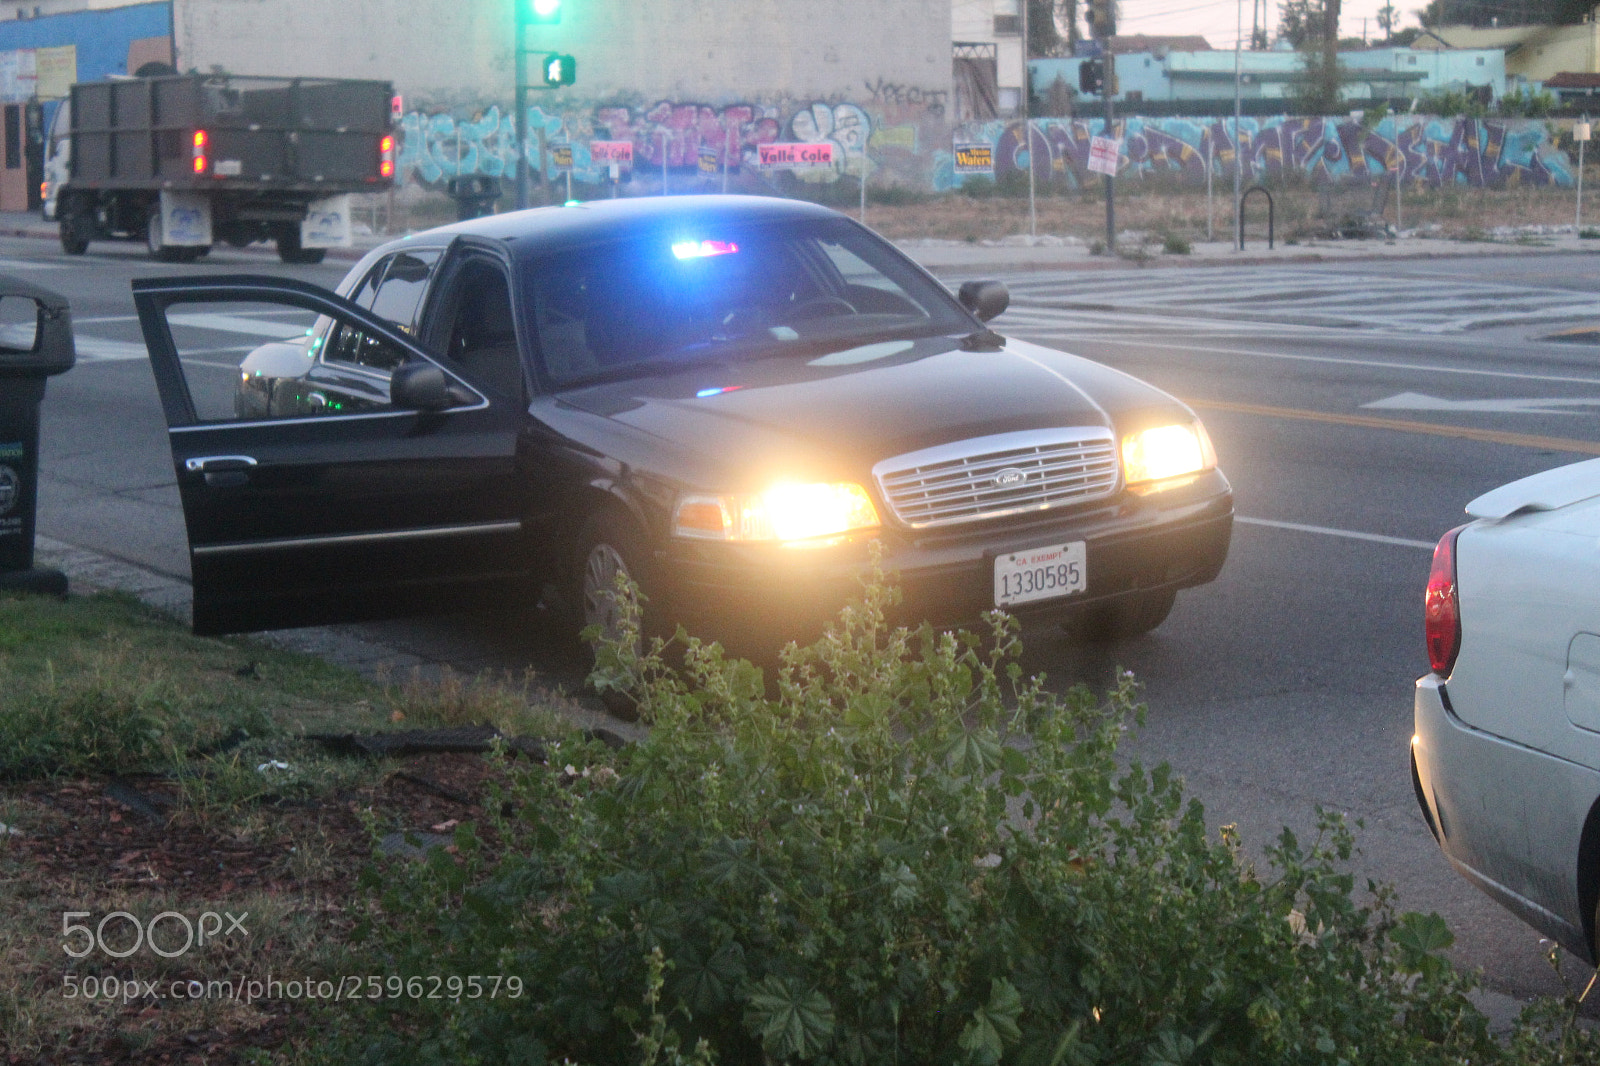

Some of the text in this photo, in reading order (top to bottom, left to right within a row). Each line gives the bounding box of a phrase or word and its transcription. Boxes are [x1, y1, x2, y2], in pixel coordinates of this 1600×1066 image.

[801, 148, 830, 162] Cole
[956, 152, 991, 166] Waters
[1016, 551, 1062, 566] CA EXEMPT
[1001, 561, 1080, 598] 1330585
